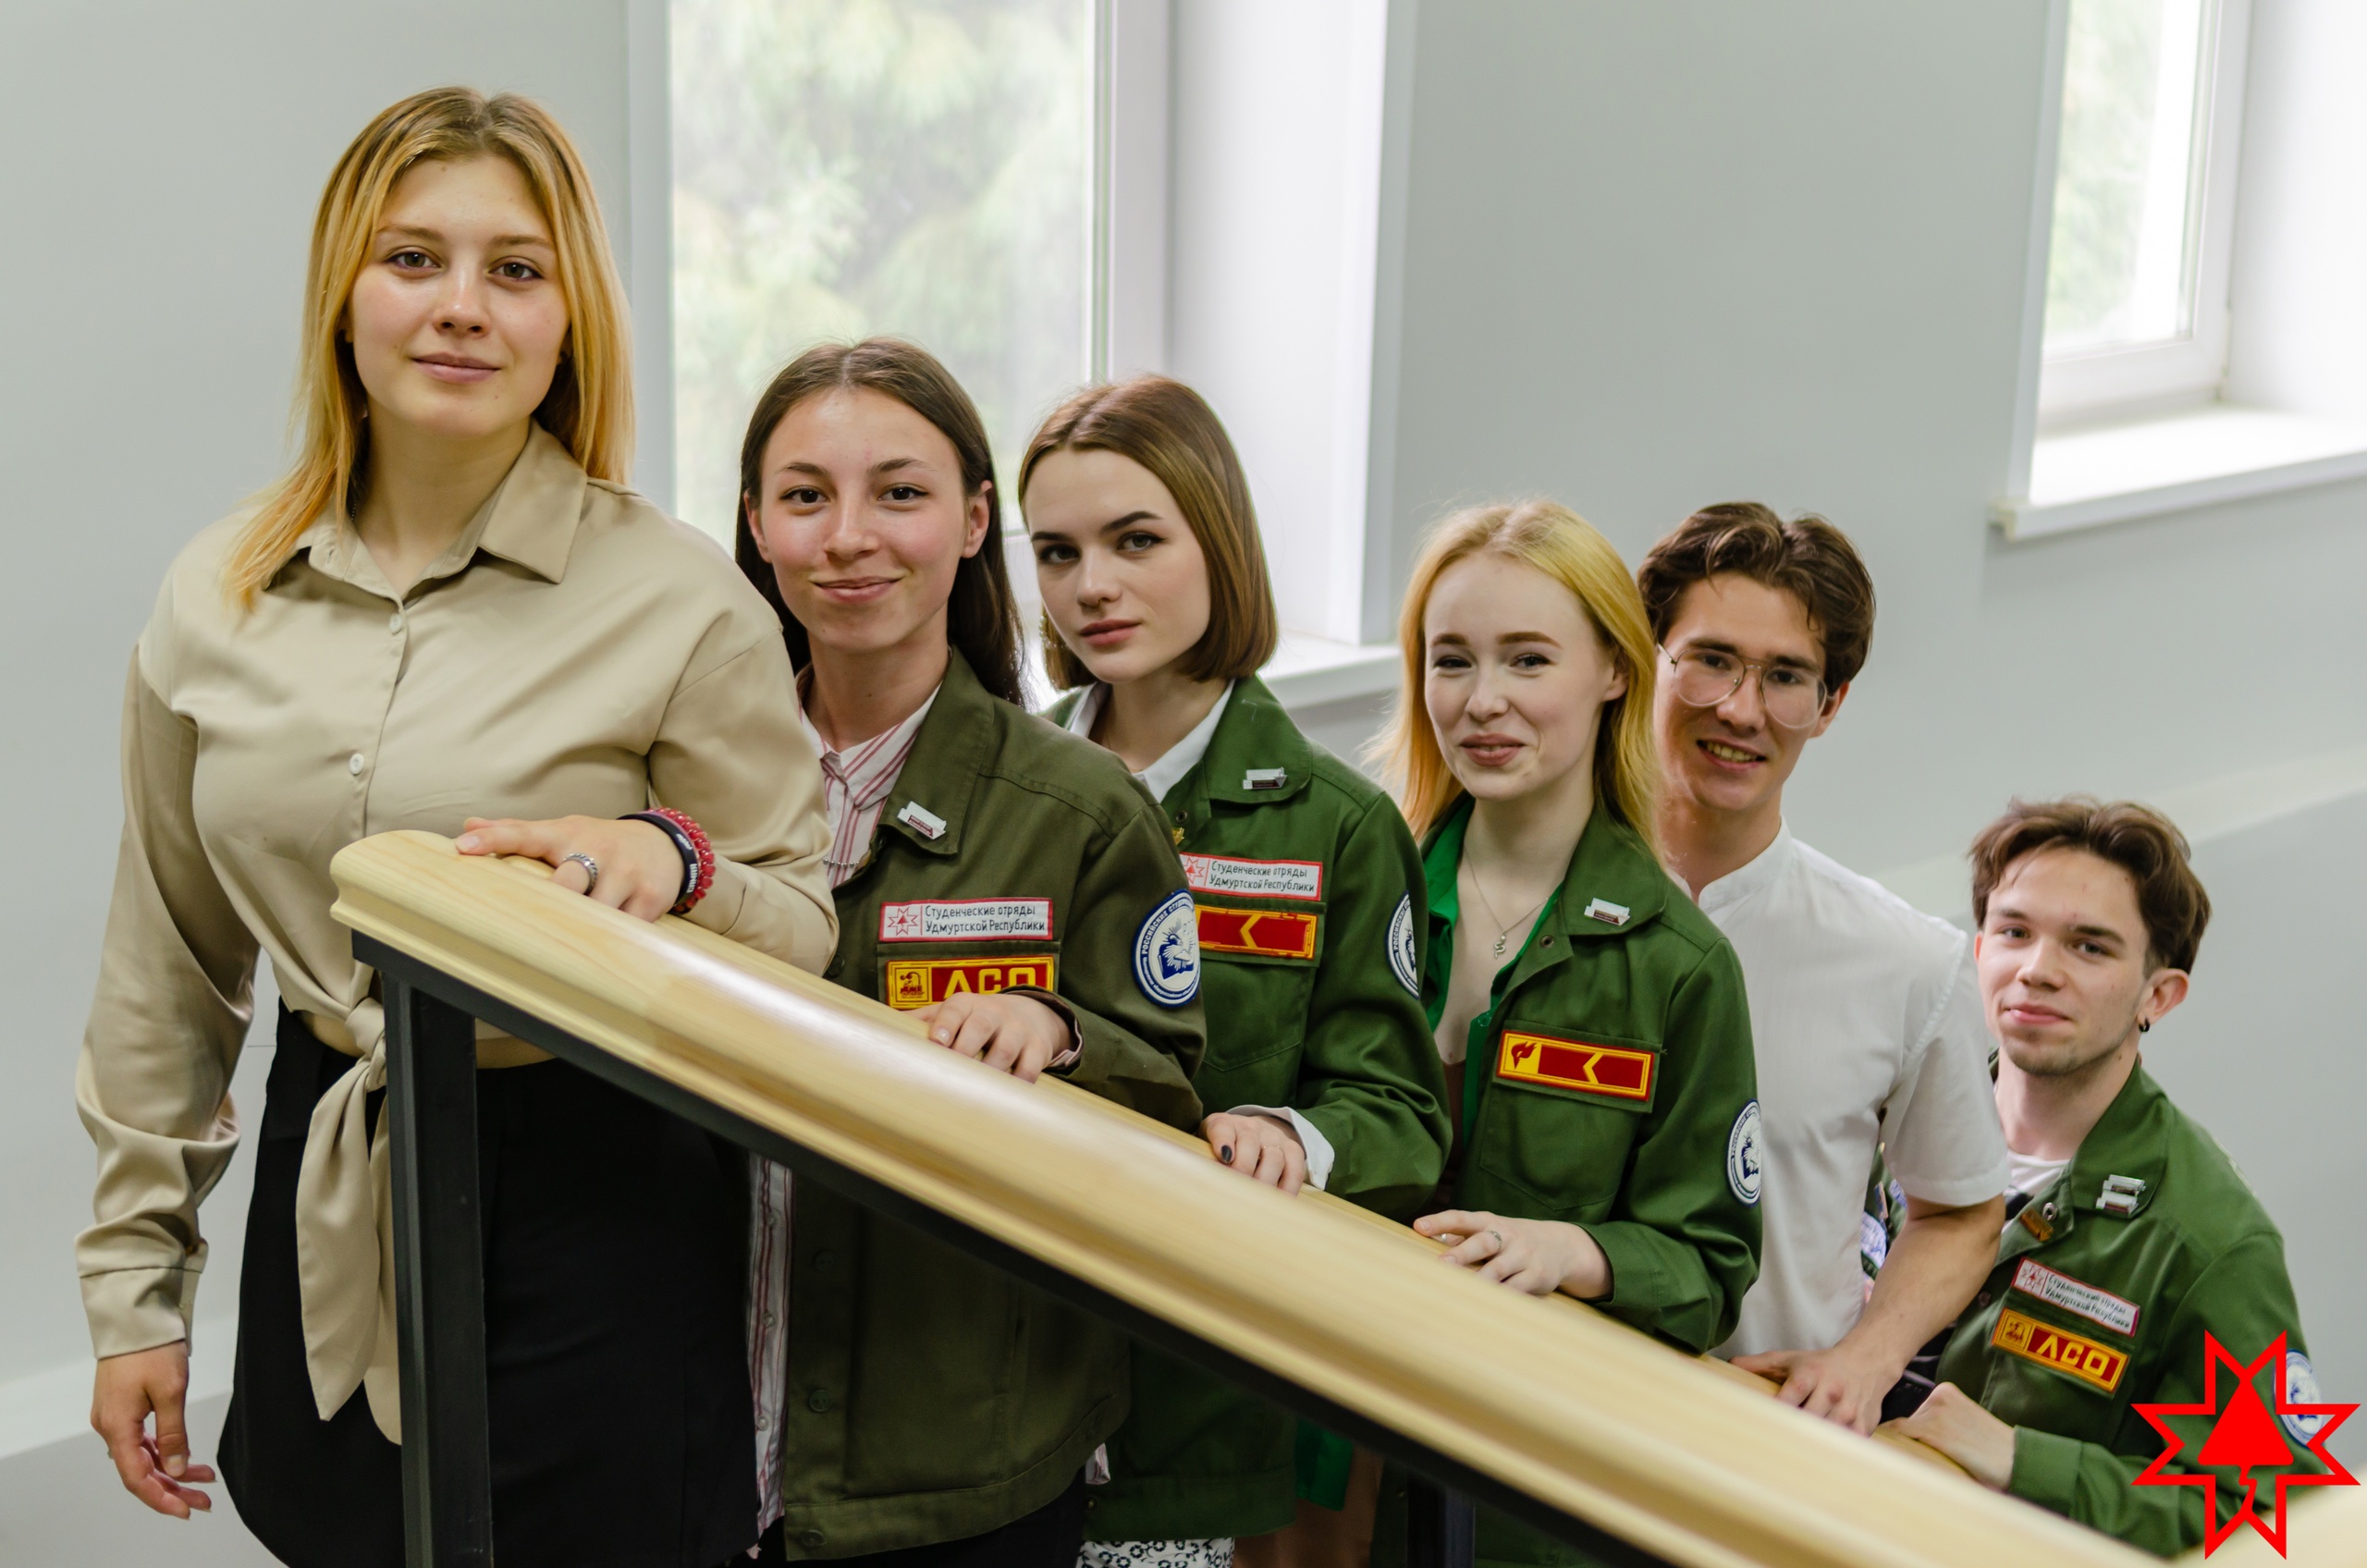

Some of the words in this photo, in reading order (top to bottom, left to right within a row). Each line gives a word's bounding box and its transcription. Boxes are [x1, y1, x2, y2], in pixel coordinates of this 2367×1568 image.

[1211, 860, 1271, 876] Студенческие
[1273, 867, 1307, 877] отряды
[1209, 874, 1262, 890] Удмуртской
[1264, 878, 1315, 892] Республики
[925, 905, 996, 920] Студенческие
[998, 906, 1036, 917] отряды
[926, 920, 987, 936] Удмуртской
[989, 918, 1046, 934] Республики
